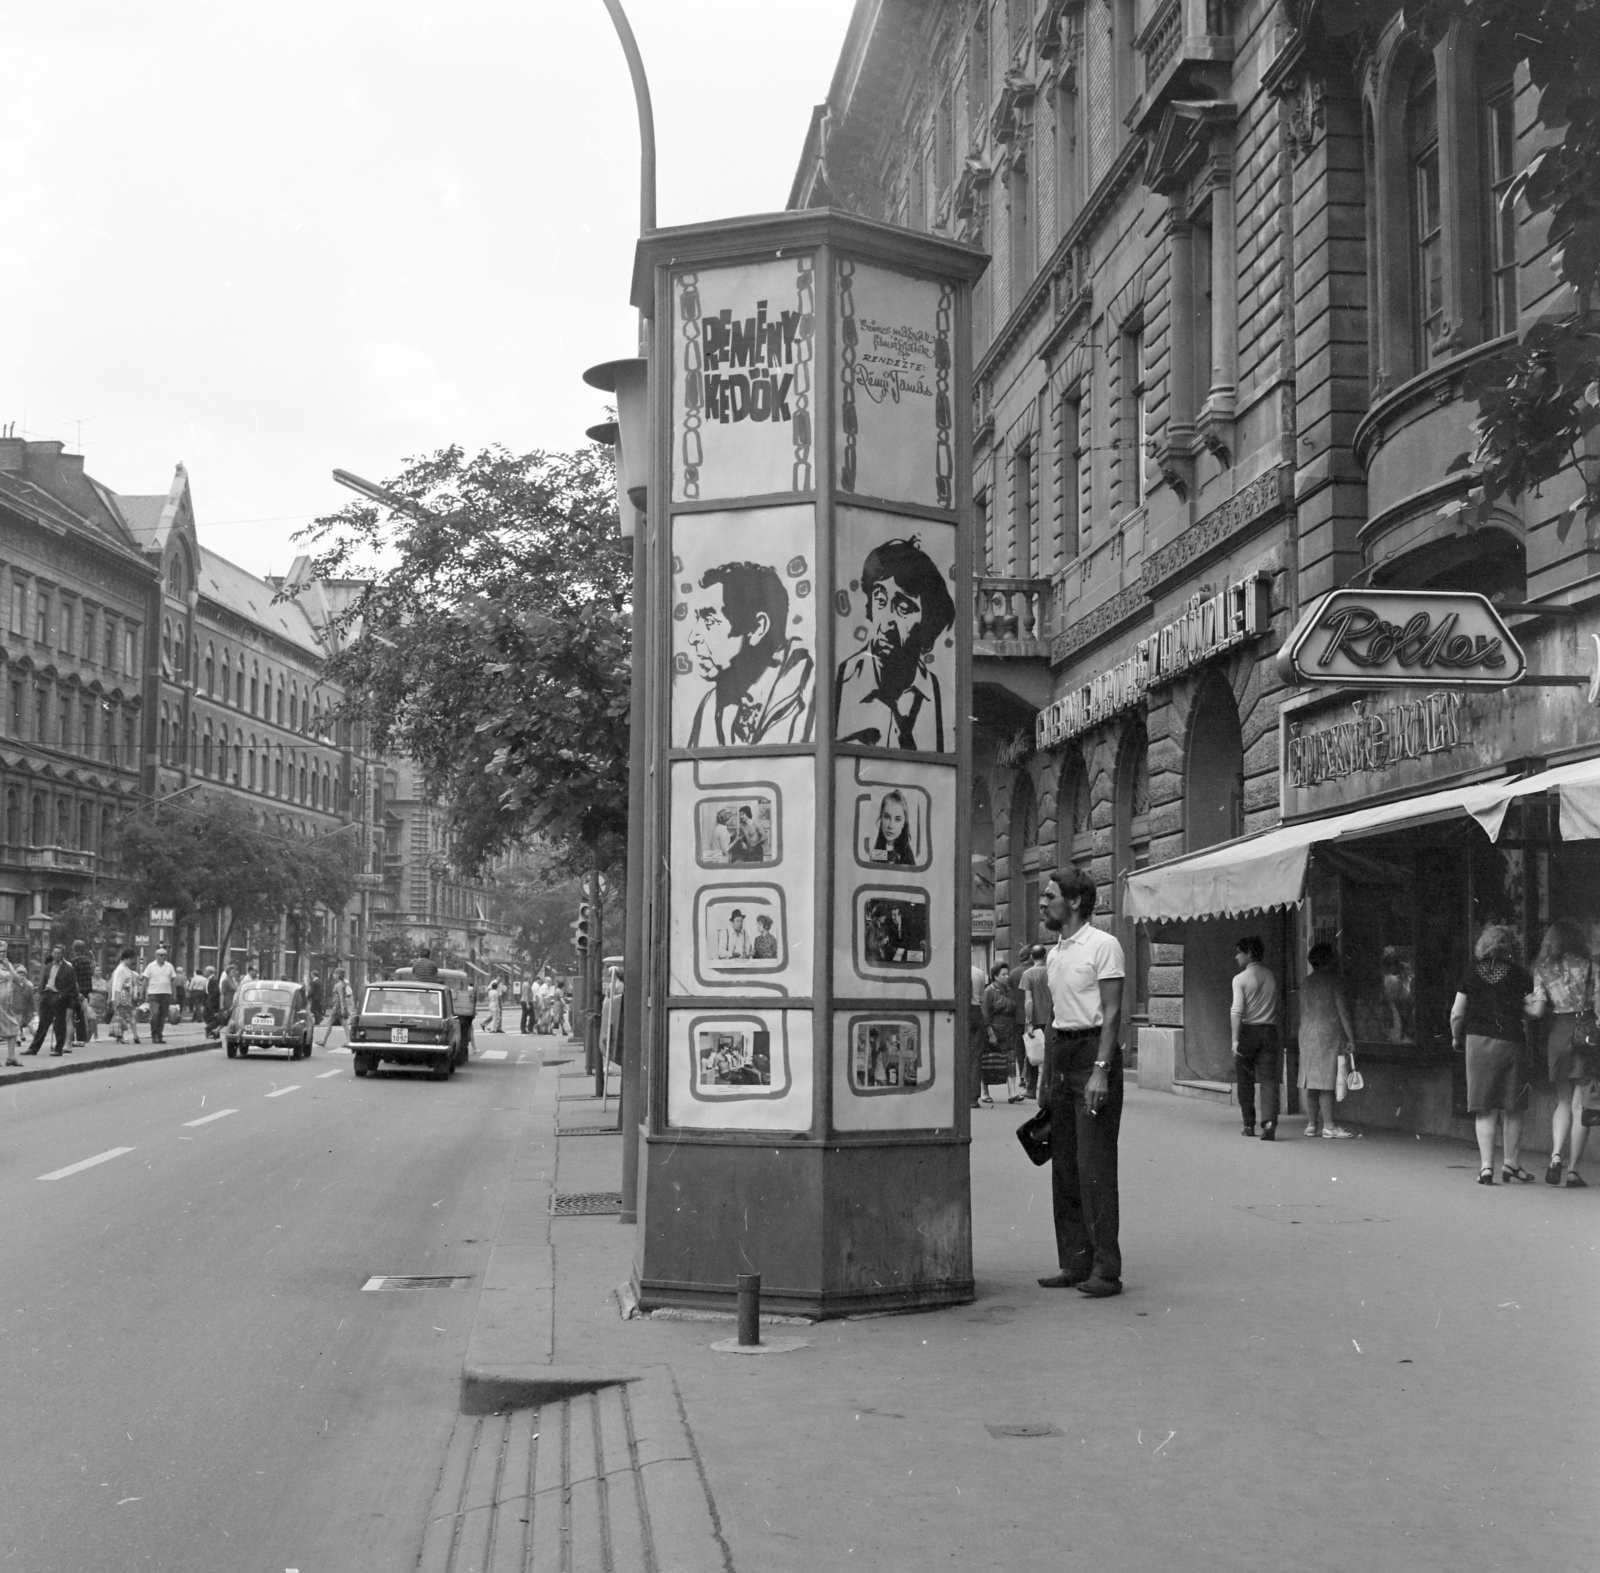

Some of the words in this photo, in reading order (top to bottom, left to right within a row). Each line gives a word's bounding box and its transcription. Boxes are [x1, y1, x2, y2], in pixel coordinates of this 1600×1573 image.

[862, 354, 926, 371] RENDEZTE:
[890, 370, 933, 404] Tamás
[151, 910, 173, 920] MM
